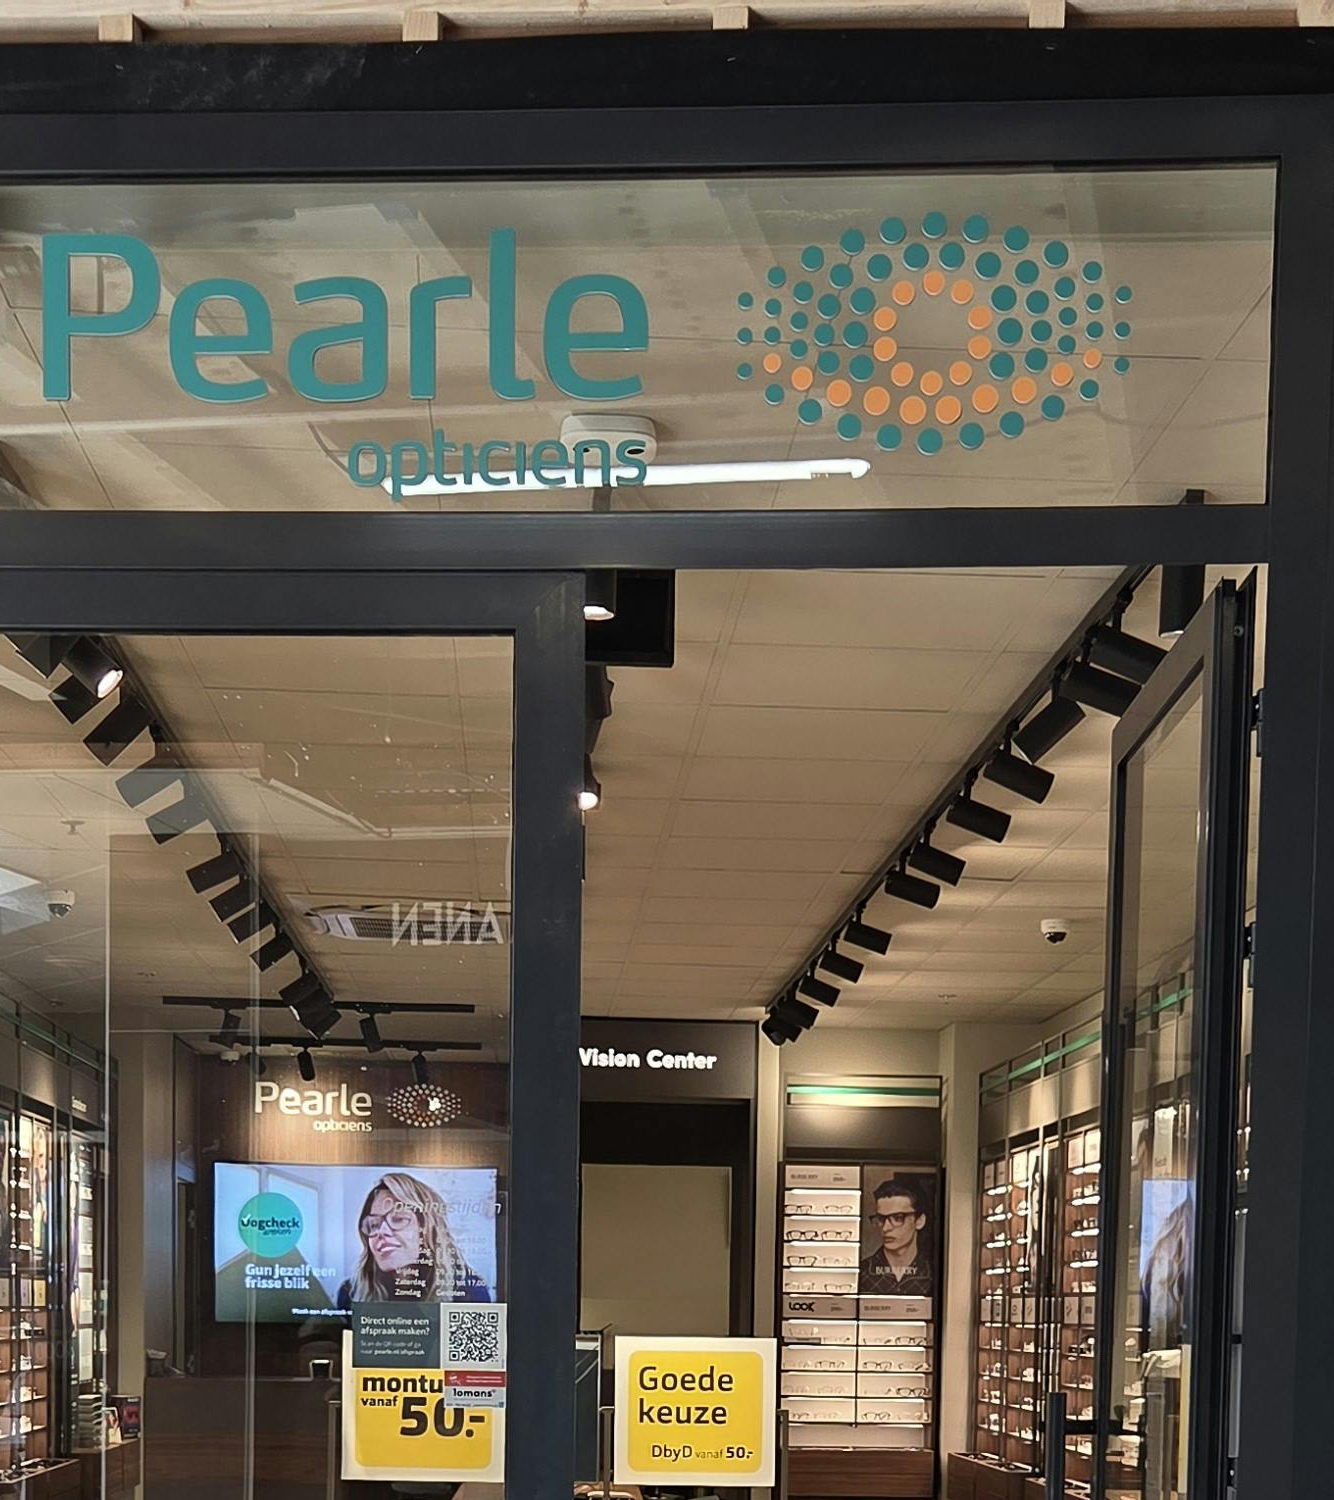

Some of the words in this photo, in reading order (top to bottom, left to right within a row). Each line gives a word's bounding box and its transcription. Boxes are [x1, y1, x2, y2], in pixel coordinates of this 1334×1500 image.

[43, 226, 649, 404] Pearle
[348, 428, 649, 502] opticiens
[579, 1047, 641, 1068] Vision
[646, 1049, 717, 1070] Center
[254, 1081, 373, 1117] Pearle
[245, 1264, 272, 1277] Gun
[274, 1264, 313, 1279] jezelf
[875, 1267, 917, 1275] BURRRY
[245, 1276, 282, 1289] frisse
[284, 1276, 310, 1290] blik
[361, 1316, 386, 1326] Direct
[387, 1316, 412, 1326] online
[414, 1318, 429, 1326] een
[361, 1326, 396, 1336] afspraak
[398, 1326, 430, 1336] maken?
[638, 1366, 734, 1393] Goede
[361, 1395, 398, 1407] vanaf
[638, 1398, 727, 1426] keuze
[651, 1444, 693, 1463] DbyD
[695, 1448, 724, 1460] vanaf
